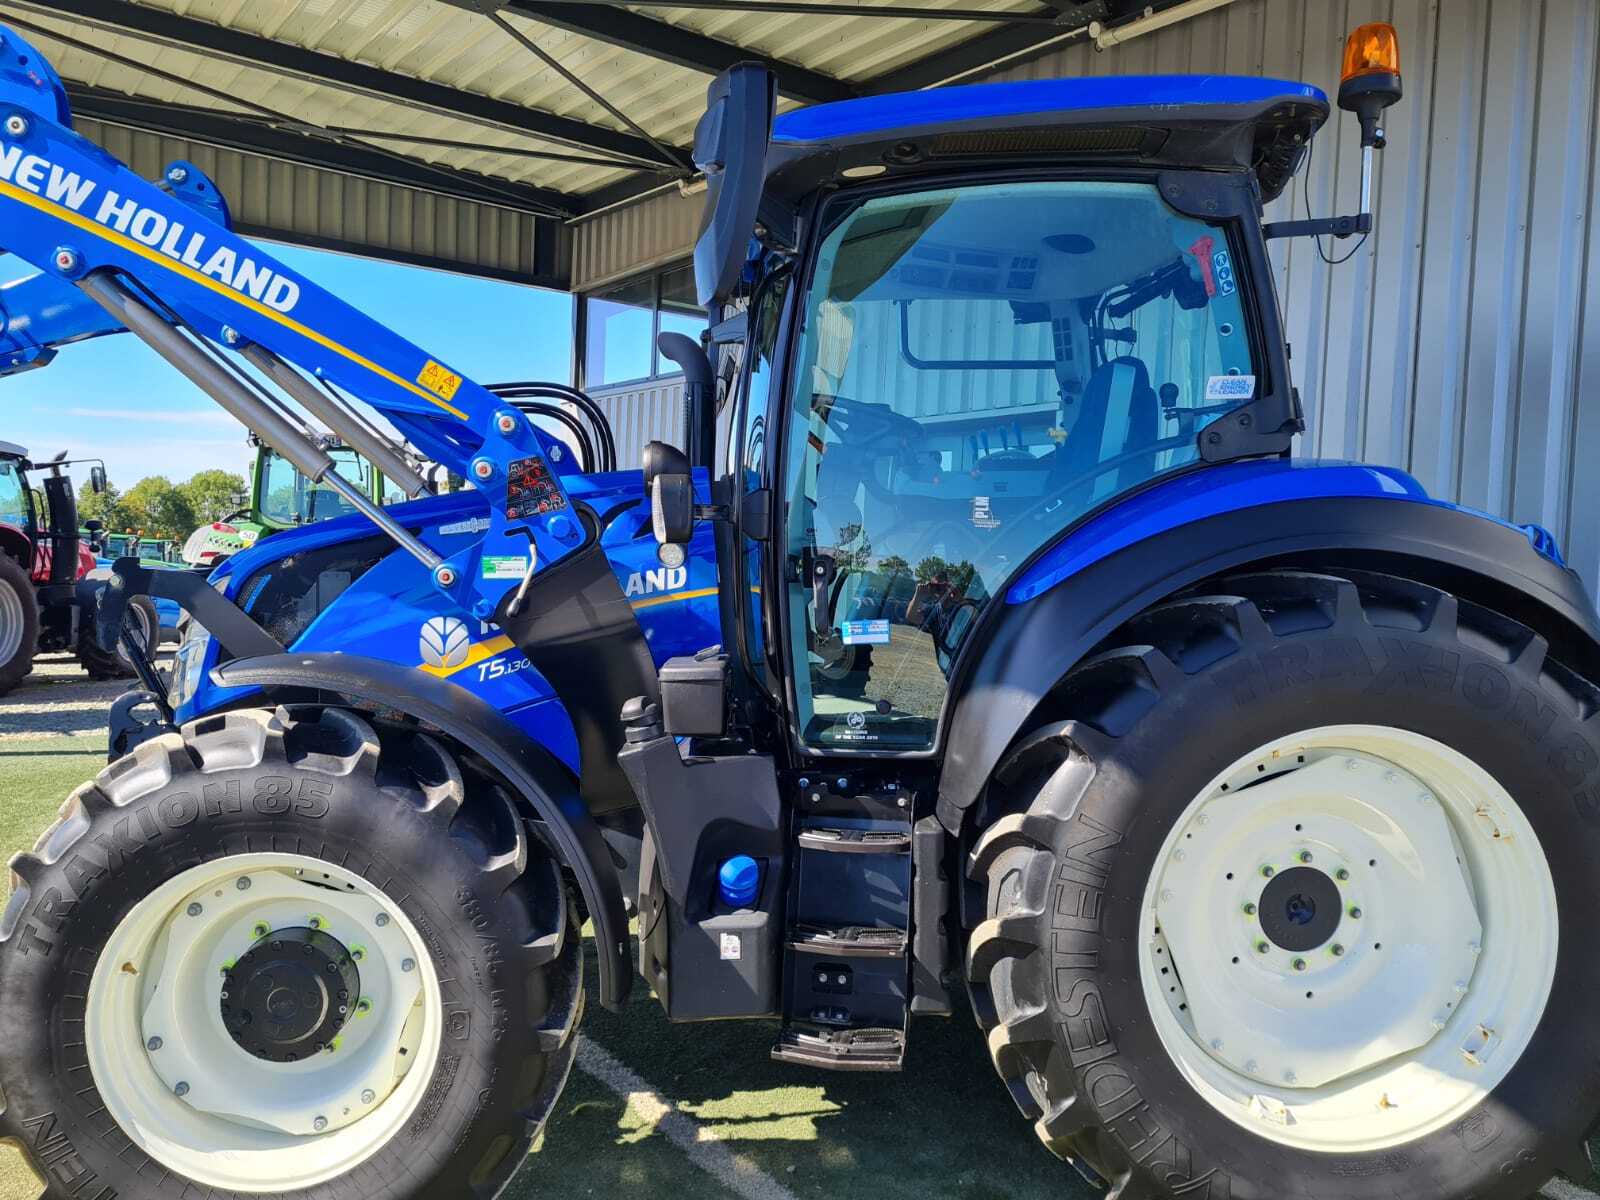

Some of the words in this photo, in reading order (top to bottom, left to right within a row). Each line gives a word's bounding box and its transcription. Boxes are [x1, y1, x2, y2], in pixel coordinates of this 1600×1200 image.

[0, 141, 97, 210] NEW
[95, 189, 301, 314] HOLLAND
[16, 779, 243, 958] TRAXION
[252, 775, 335, 818] 85
[1050, 811, 1232, 1200] VREDESTEIN
